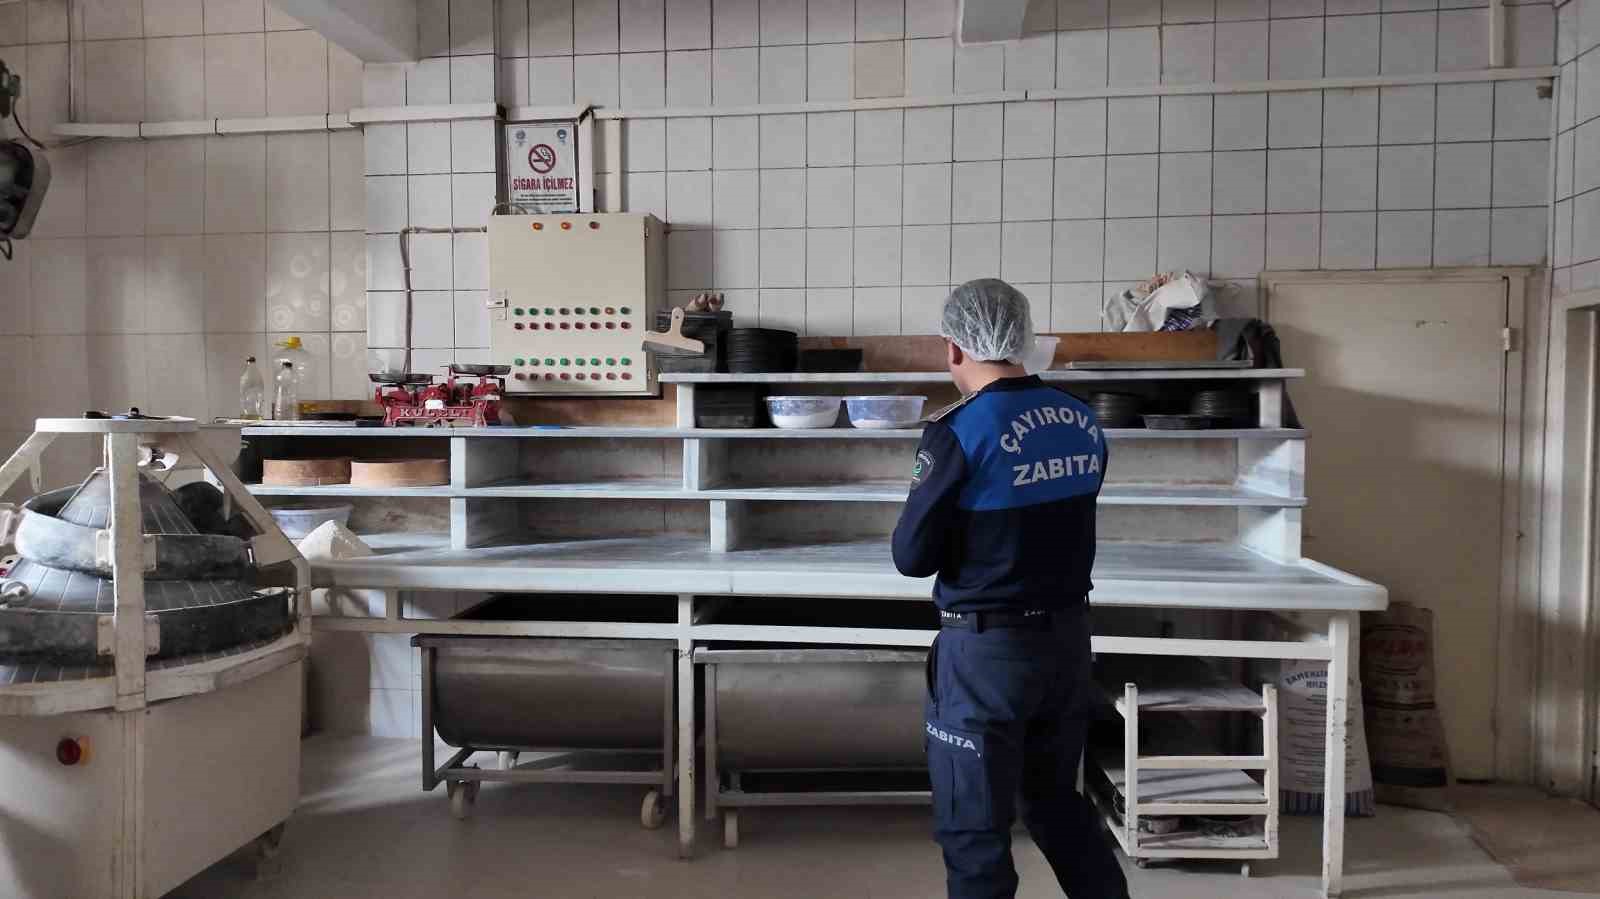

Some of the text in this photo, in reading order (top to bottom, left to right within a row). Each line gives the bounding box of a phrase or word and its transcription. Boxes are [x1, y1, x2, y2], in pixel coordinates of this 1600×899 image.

[513, 176, 574, 192] SİGARA İÇİLMEZ
[1000, 406, 1099, 455] ÇAYIROVA
[1013, 454, 1100, 486] ZABITA
[926, 722, 976, 750] ZABITA
